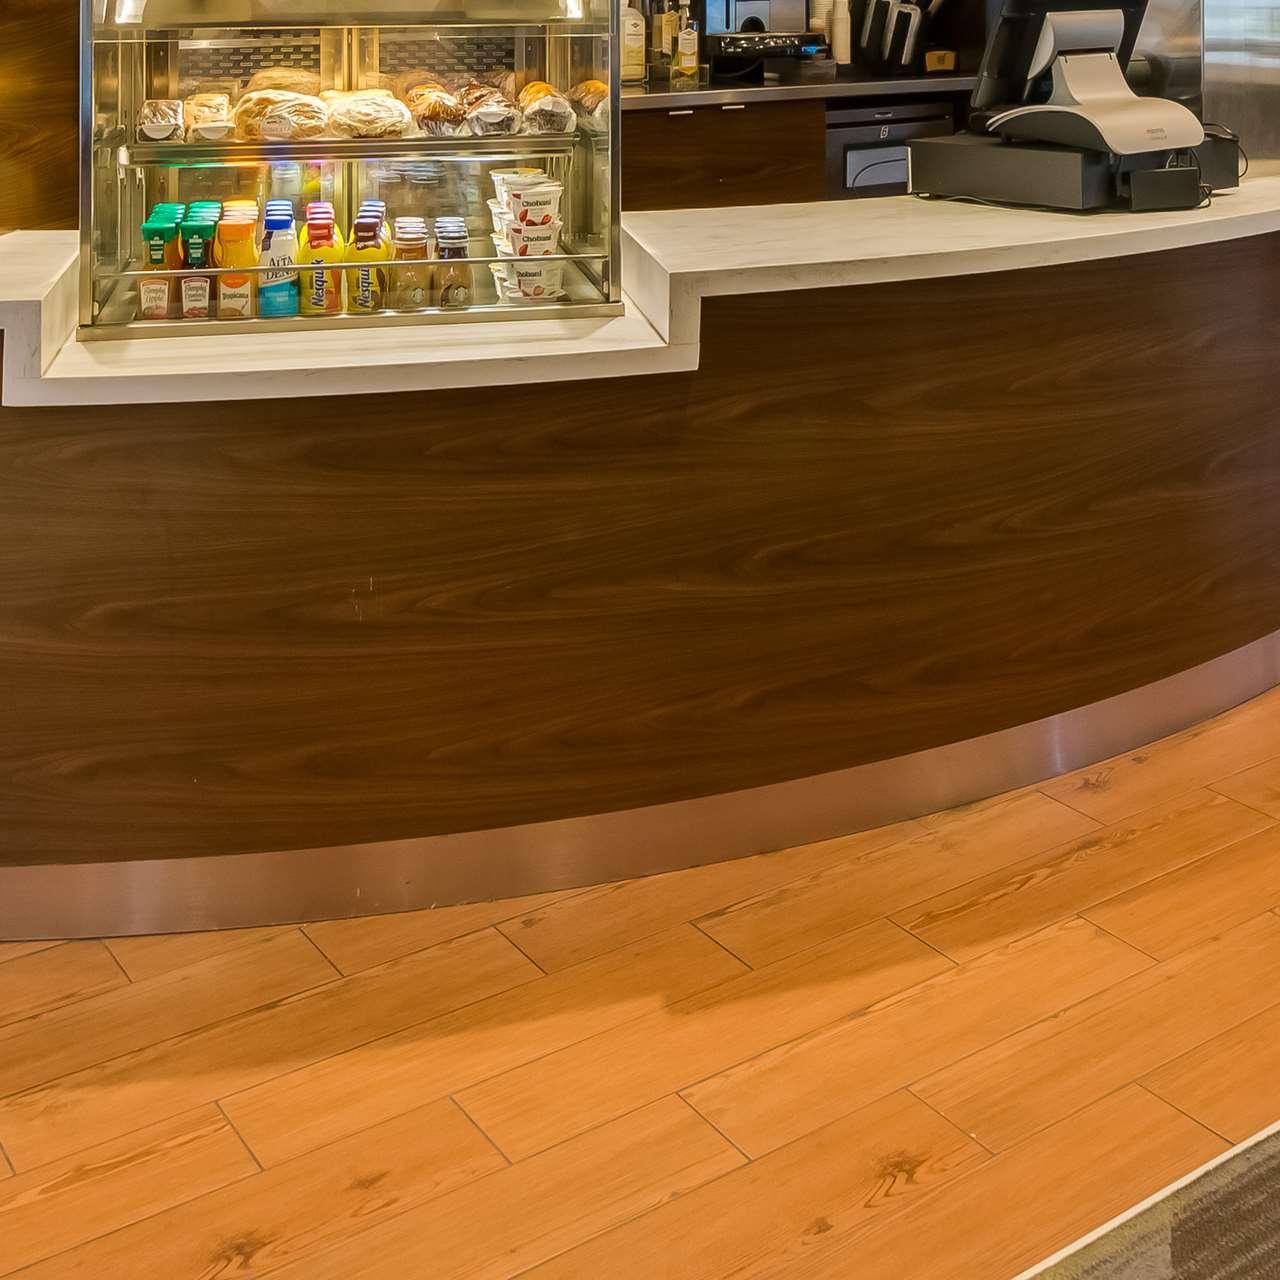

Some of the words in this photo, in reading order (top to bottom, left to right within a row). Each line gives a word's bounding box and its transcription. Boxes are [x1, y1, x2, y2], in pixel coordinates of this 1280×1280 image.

[522, 199, 551, 207] Chobani
[522, 234, 551, 242] Chobani
[311, 259, 328, 308] Nesquk
